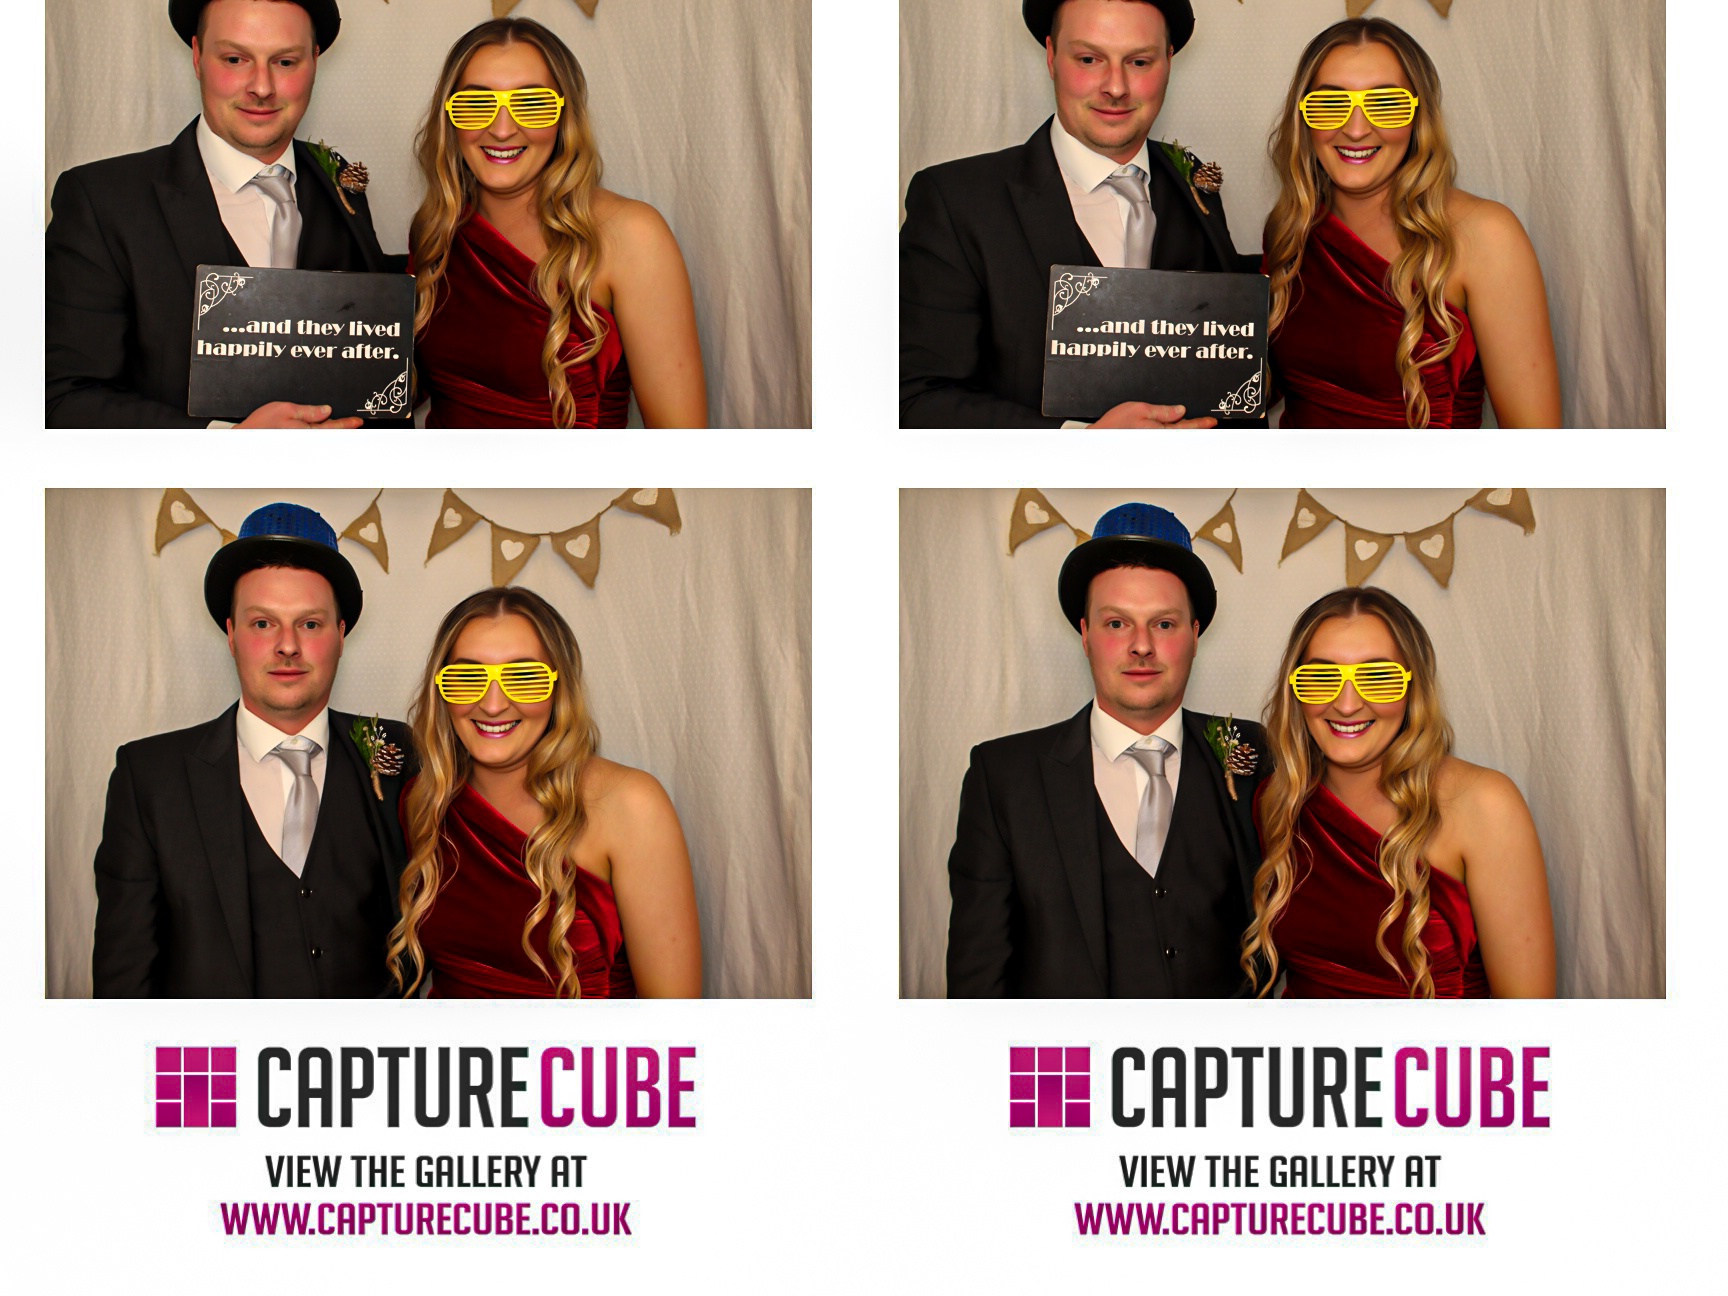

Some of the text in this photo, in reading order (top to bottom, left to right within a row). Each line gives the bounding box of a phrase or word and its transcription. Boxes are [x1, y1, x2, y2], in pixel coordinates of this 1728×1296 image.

[297, 320, 345, 336] they
[349, 321, 401, 337] lived
[1151, 320, 1199, 336] they
[1203, 321, 1255, 337] lived
[197, 339, 400, 360] happily ever after.
[1051, 339, 1254, 360] happily ever after.
